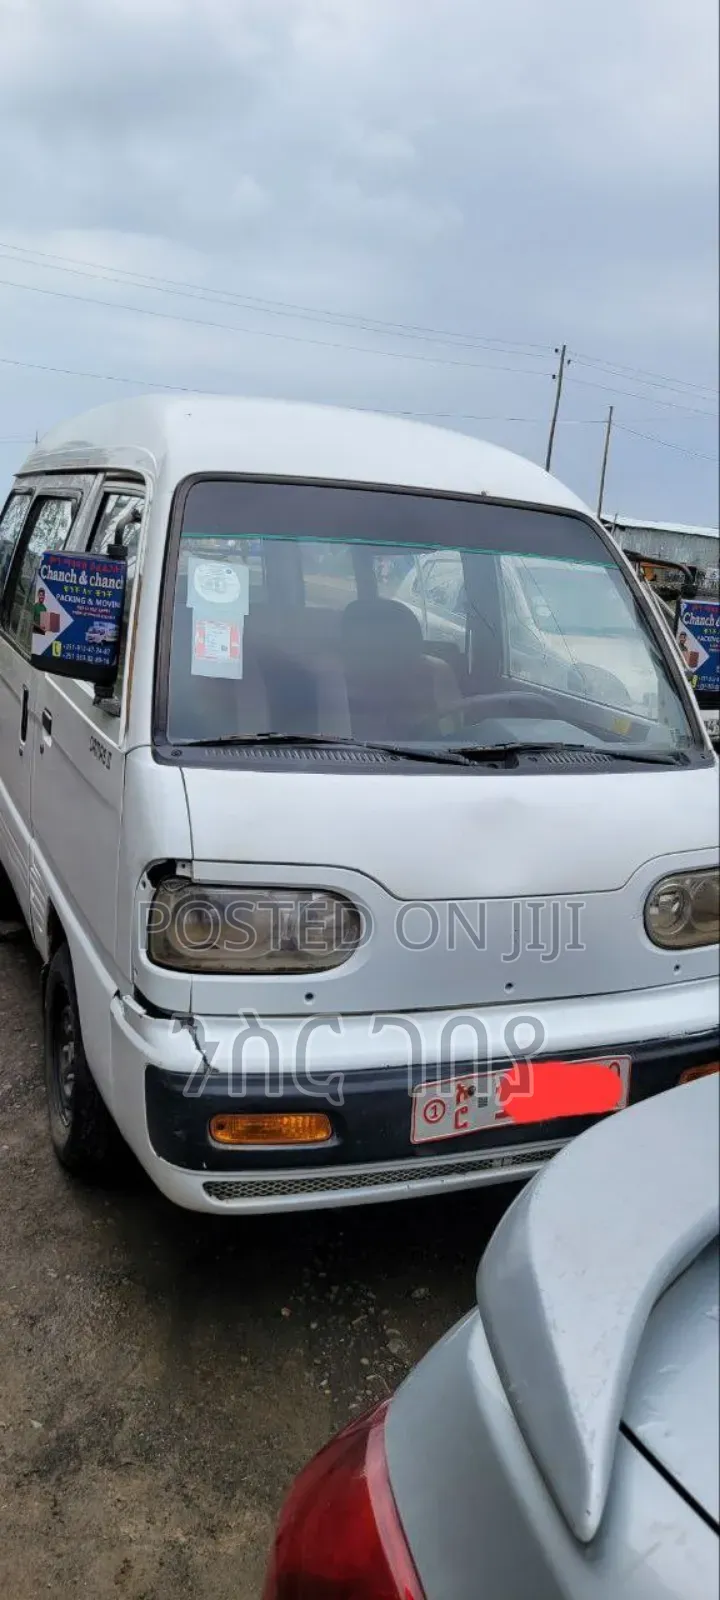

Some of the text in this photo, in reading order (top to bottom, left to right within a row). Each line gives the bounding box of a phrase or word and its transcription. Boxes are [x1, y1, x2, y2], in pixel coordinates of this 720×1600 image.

[40, 564, 77, 584] Chanch
[79, 570, 88, 586] &
[56, 594, 86, 605] PACKING
[88, 597, 94, 606] &
[683, 611, 715, 626] Chanch
